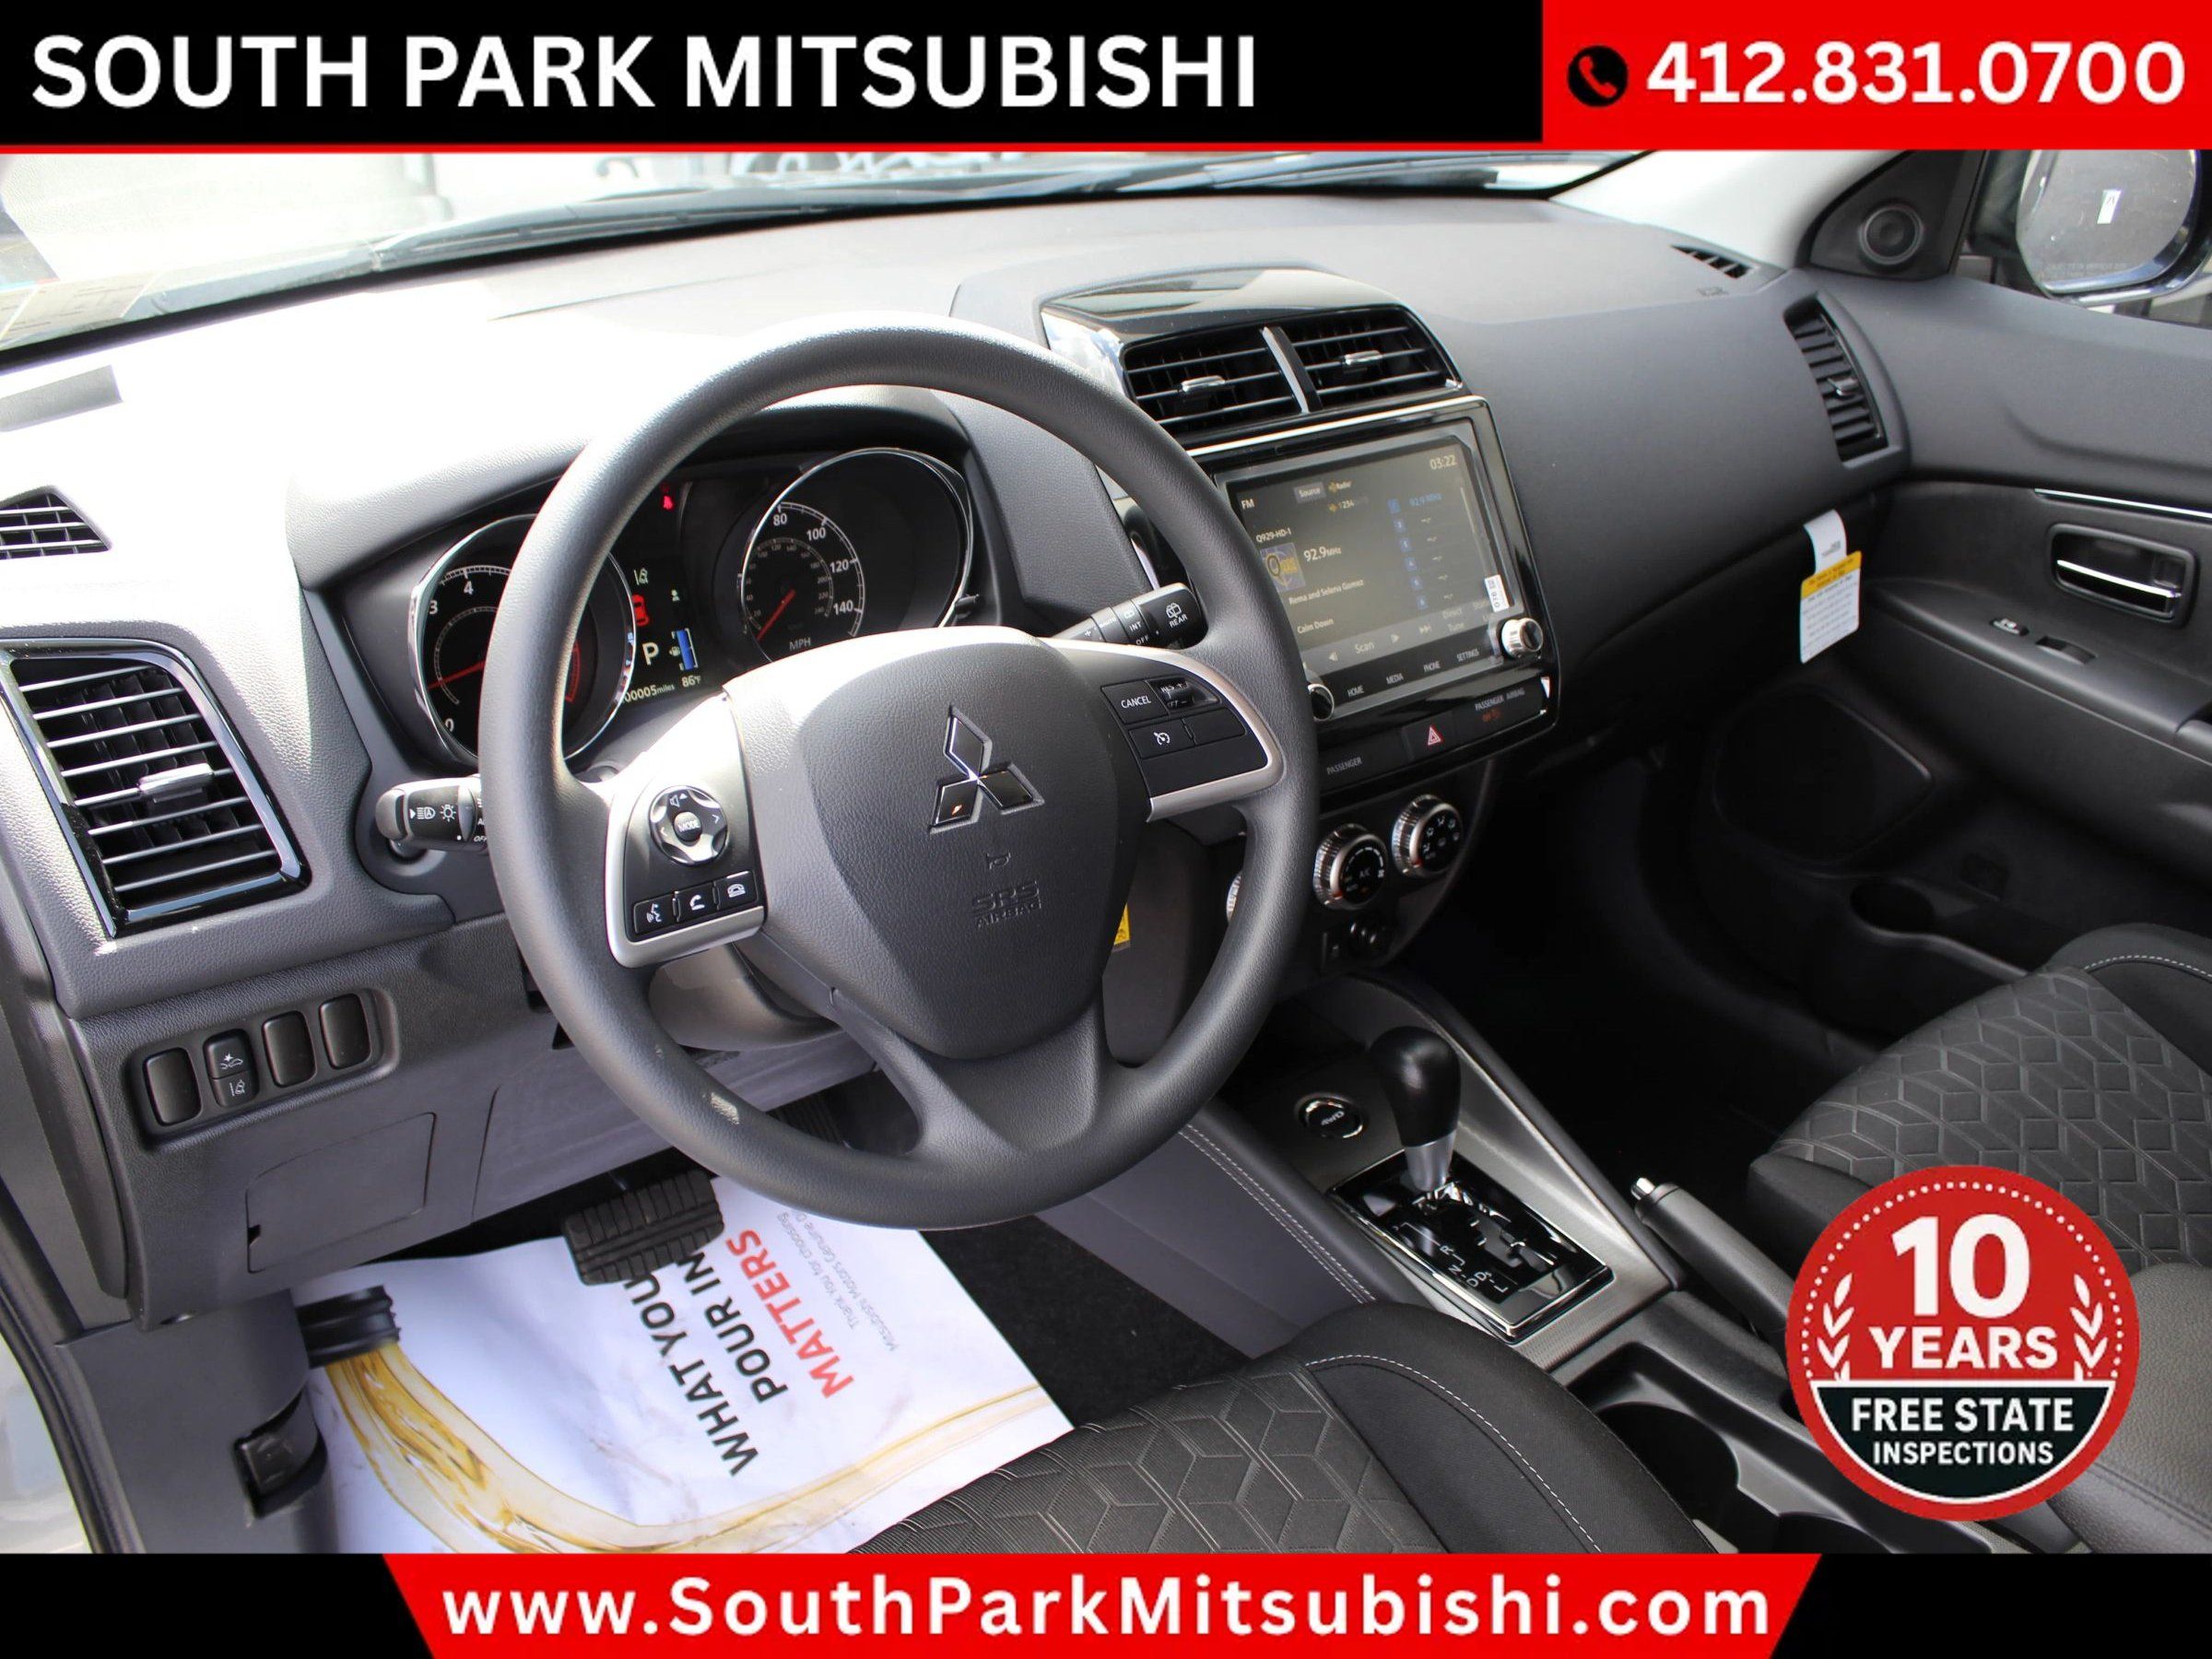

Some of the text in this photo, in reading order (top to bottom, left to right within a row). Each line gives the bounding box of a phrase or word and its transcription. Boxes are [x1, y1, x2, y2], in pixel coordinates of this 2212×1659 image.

[1430, 454, 1458, 470] 03:22
[1241, 499, 1254, 509] FM
[772, 512, 788, 526] 80
[806, 527, 827, 541] 100
[830, 559, 850, 573] 120
[464, 581, 474, 594] 4
[429, 600, 439, 615] 3
[833, 600, 853, 616] 140
[1129, 621, 1142, 631] INT
[1169, 614, 1188, 629] REAR
[1313, 618, 1335, 629] Down
[789, 637, 811, 651] MPH
[1136, 635, 1149, 645] OFF
[642, 641, 659, 666] P
[1355, 641, 1375, 654] Scan
[1456, 648, 1480, 662] SETTINGS
[1423, 661, 1441, 673] PHONE
[1386, 673, 1405, 685] MEDIA
[1347, 685, 1365, 698] HOME
[1121, 695, 1152, 709] CANCEL
[1475, 695, 1505, 712] PASSENGER
[1326, 756, 1363, 775] PASSENGER
[677, 818, 700, 832] MODE
[1440, 1245, 1454, 1255] R
[1448, 1264, 1462, 1276] N
[1466, 1277, 1479, 1288] D
[1493, 1285, 1509, 1293] L
[724, 1229, 855, 1399] MATTERS
[676, 1251, 789, 1404] POUR IN
[668, 1359, 759, 1477] WHAT
